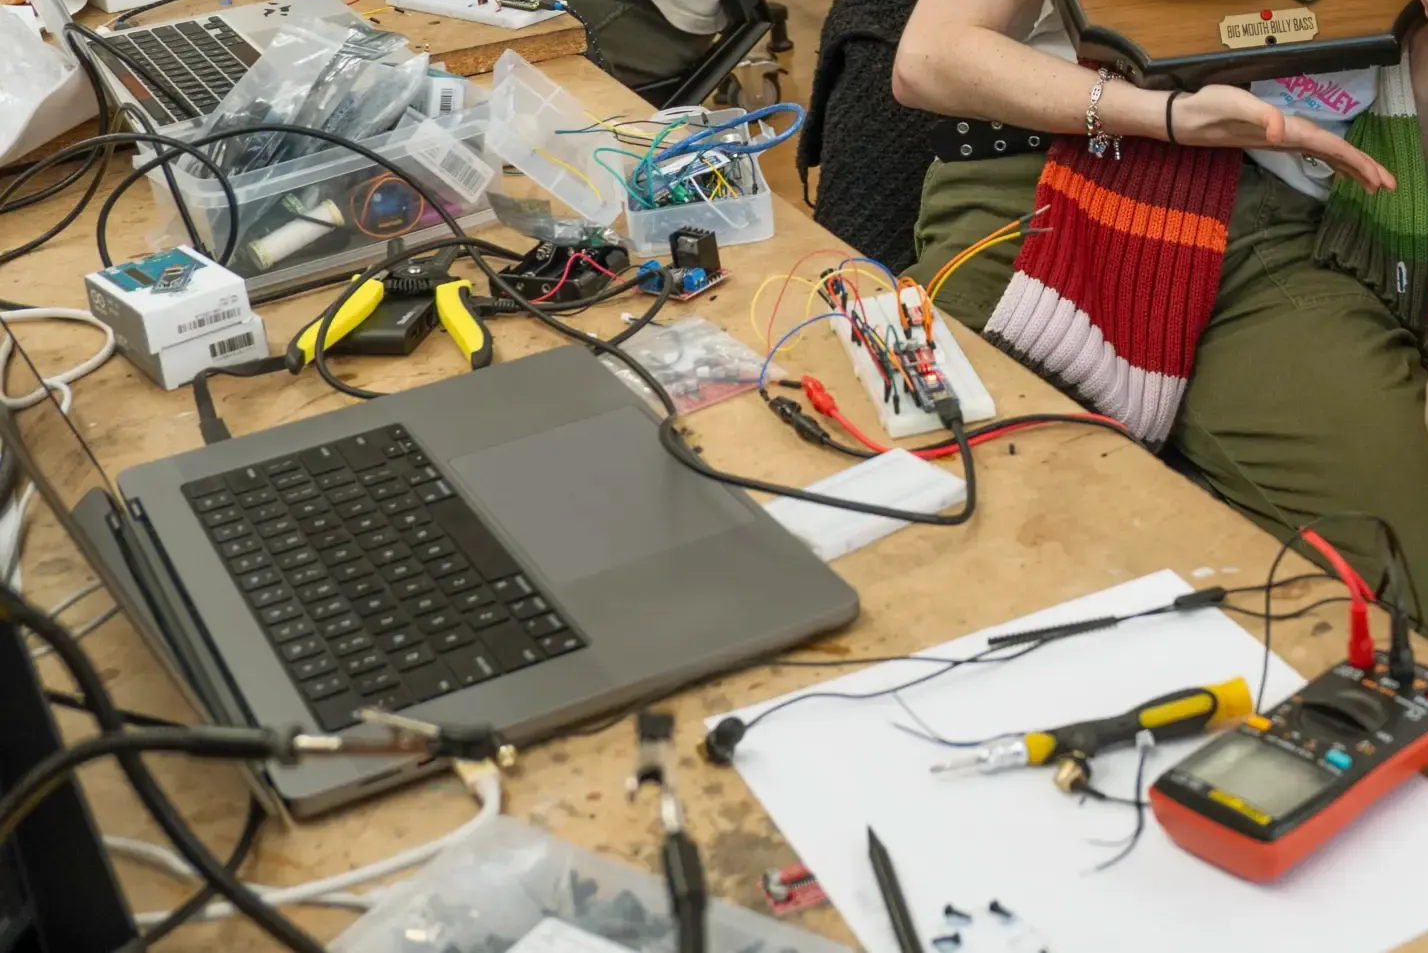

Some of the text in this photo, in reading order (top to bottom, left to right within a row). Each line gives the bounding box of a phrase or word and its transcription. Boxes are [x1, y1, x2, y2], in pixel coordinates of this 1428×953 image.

[1227, 16, 1315, 39] BIG MOUTH BILLY BASS
